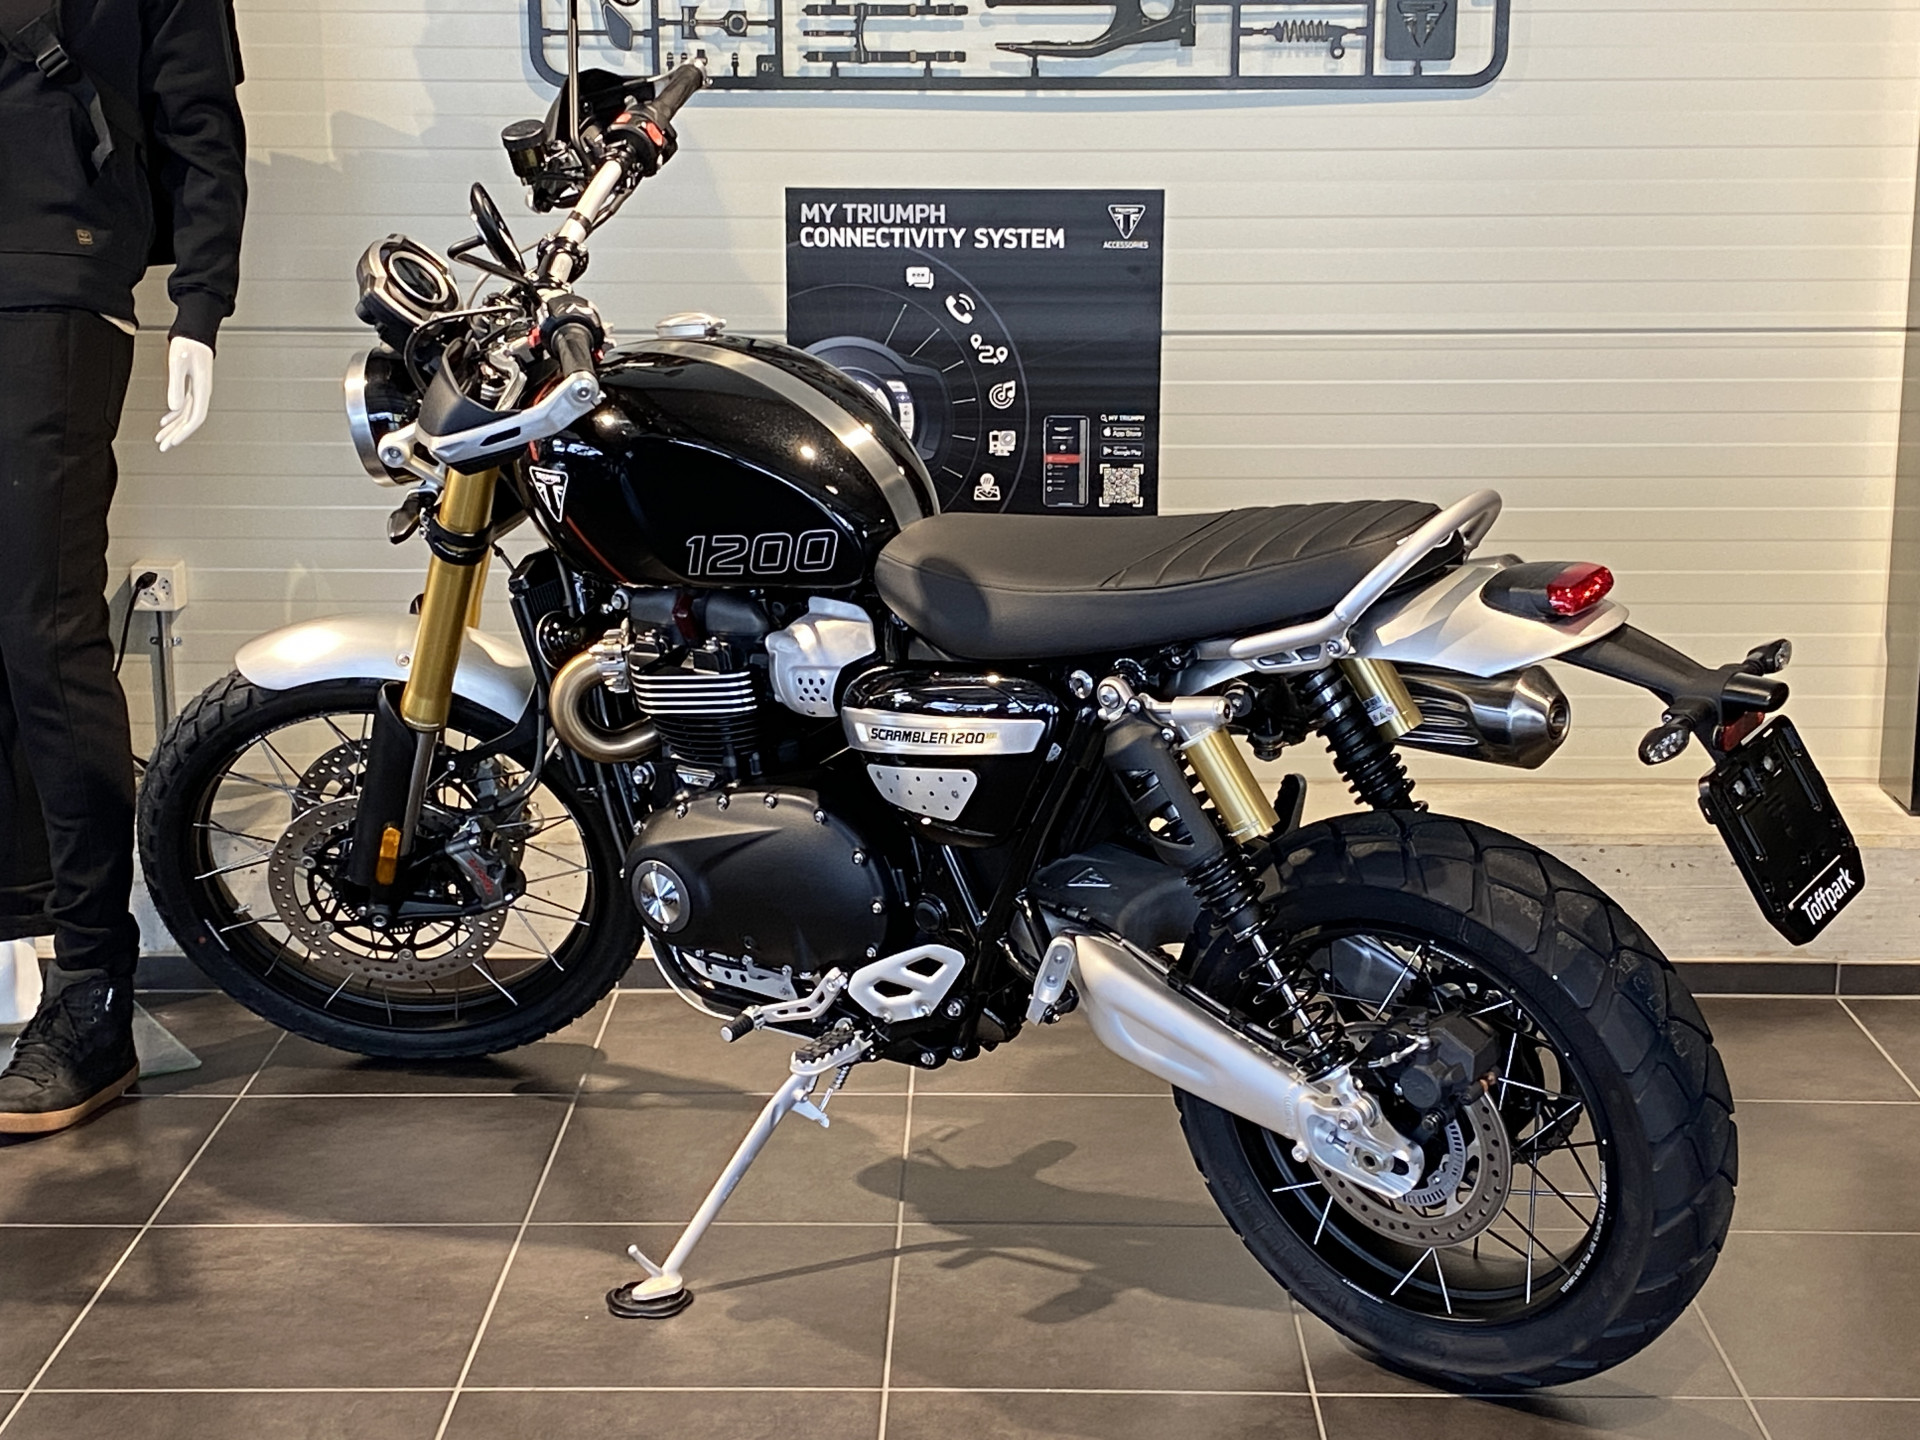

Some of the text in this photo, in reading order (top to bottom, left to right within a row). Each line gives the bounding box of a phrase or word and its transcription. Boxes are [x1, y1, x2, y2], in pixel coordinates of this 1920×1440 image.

[801, 203, 946, 224] MY TRIUMPH
[800, 226, 1065, 249] CONNECTIVITY SYSTEM
[686, 529, 838, 575] 1200
[870, 728, 948, 745] SCRAMBLER
[950, 732, 986, 744] 1200
[1800, 867, 1856, 926] Töffpark
